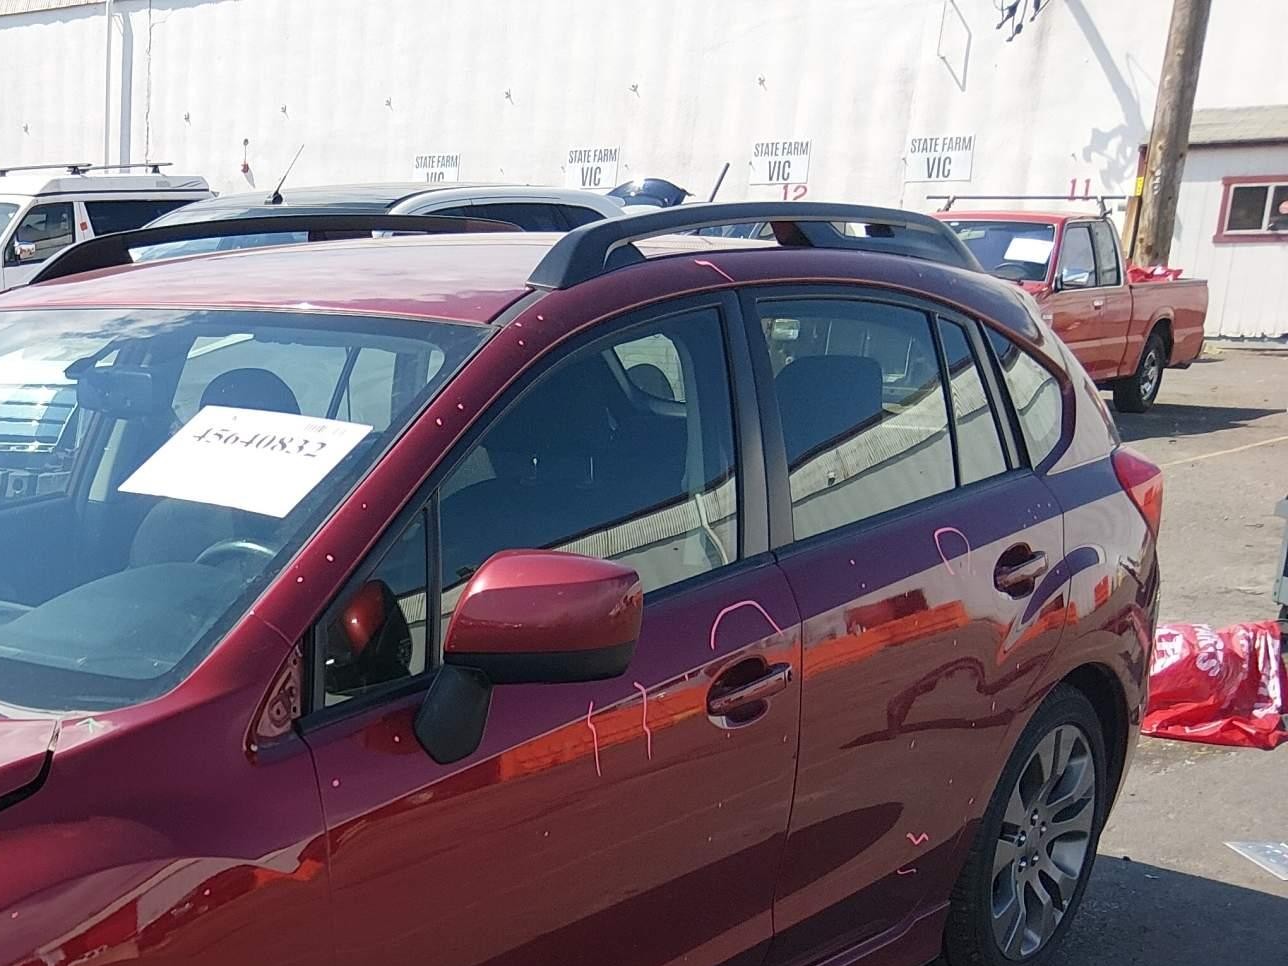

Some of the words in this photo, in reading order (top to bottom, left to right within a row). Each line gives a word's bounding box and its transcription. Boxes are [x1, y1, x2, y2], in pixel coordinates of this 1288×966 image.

[753, 142, 780, 158] STATE
[781, 140, 809, 157] FARM
[910, 137, 939, 154] STATE
[941, 135, 972, 153] FARM
[415, 155, 436, 169] STATE
[437, 154, 458, 169] FARM
[568, 149, 592, 164] STATE
[593, 148, 617, 163] FARM
[580, 166, 602, 187] VIC
[768, 160, 791, 182] VIC
[926, 156, 952, 179] VIC
[783, 183, 808, 201] 12
[1067, 178, 1092, 202] 11
[193, 427, 328, 458] 45640832
